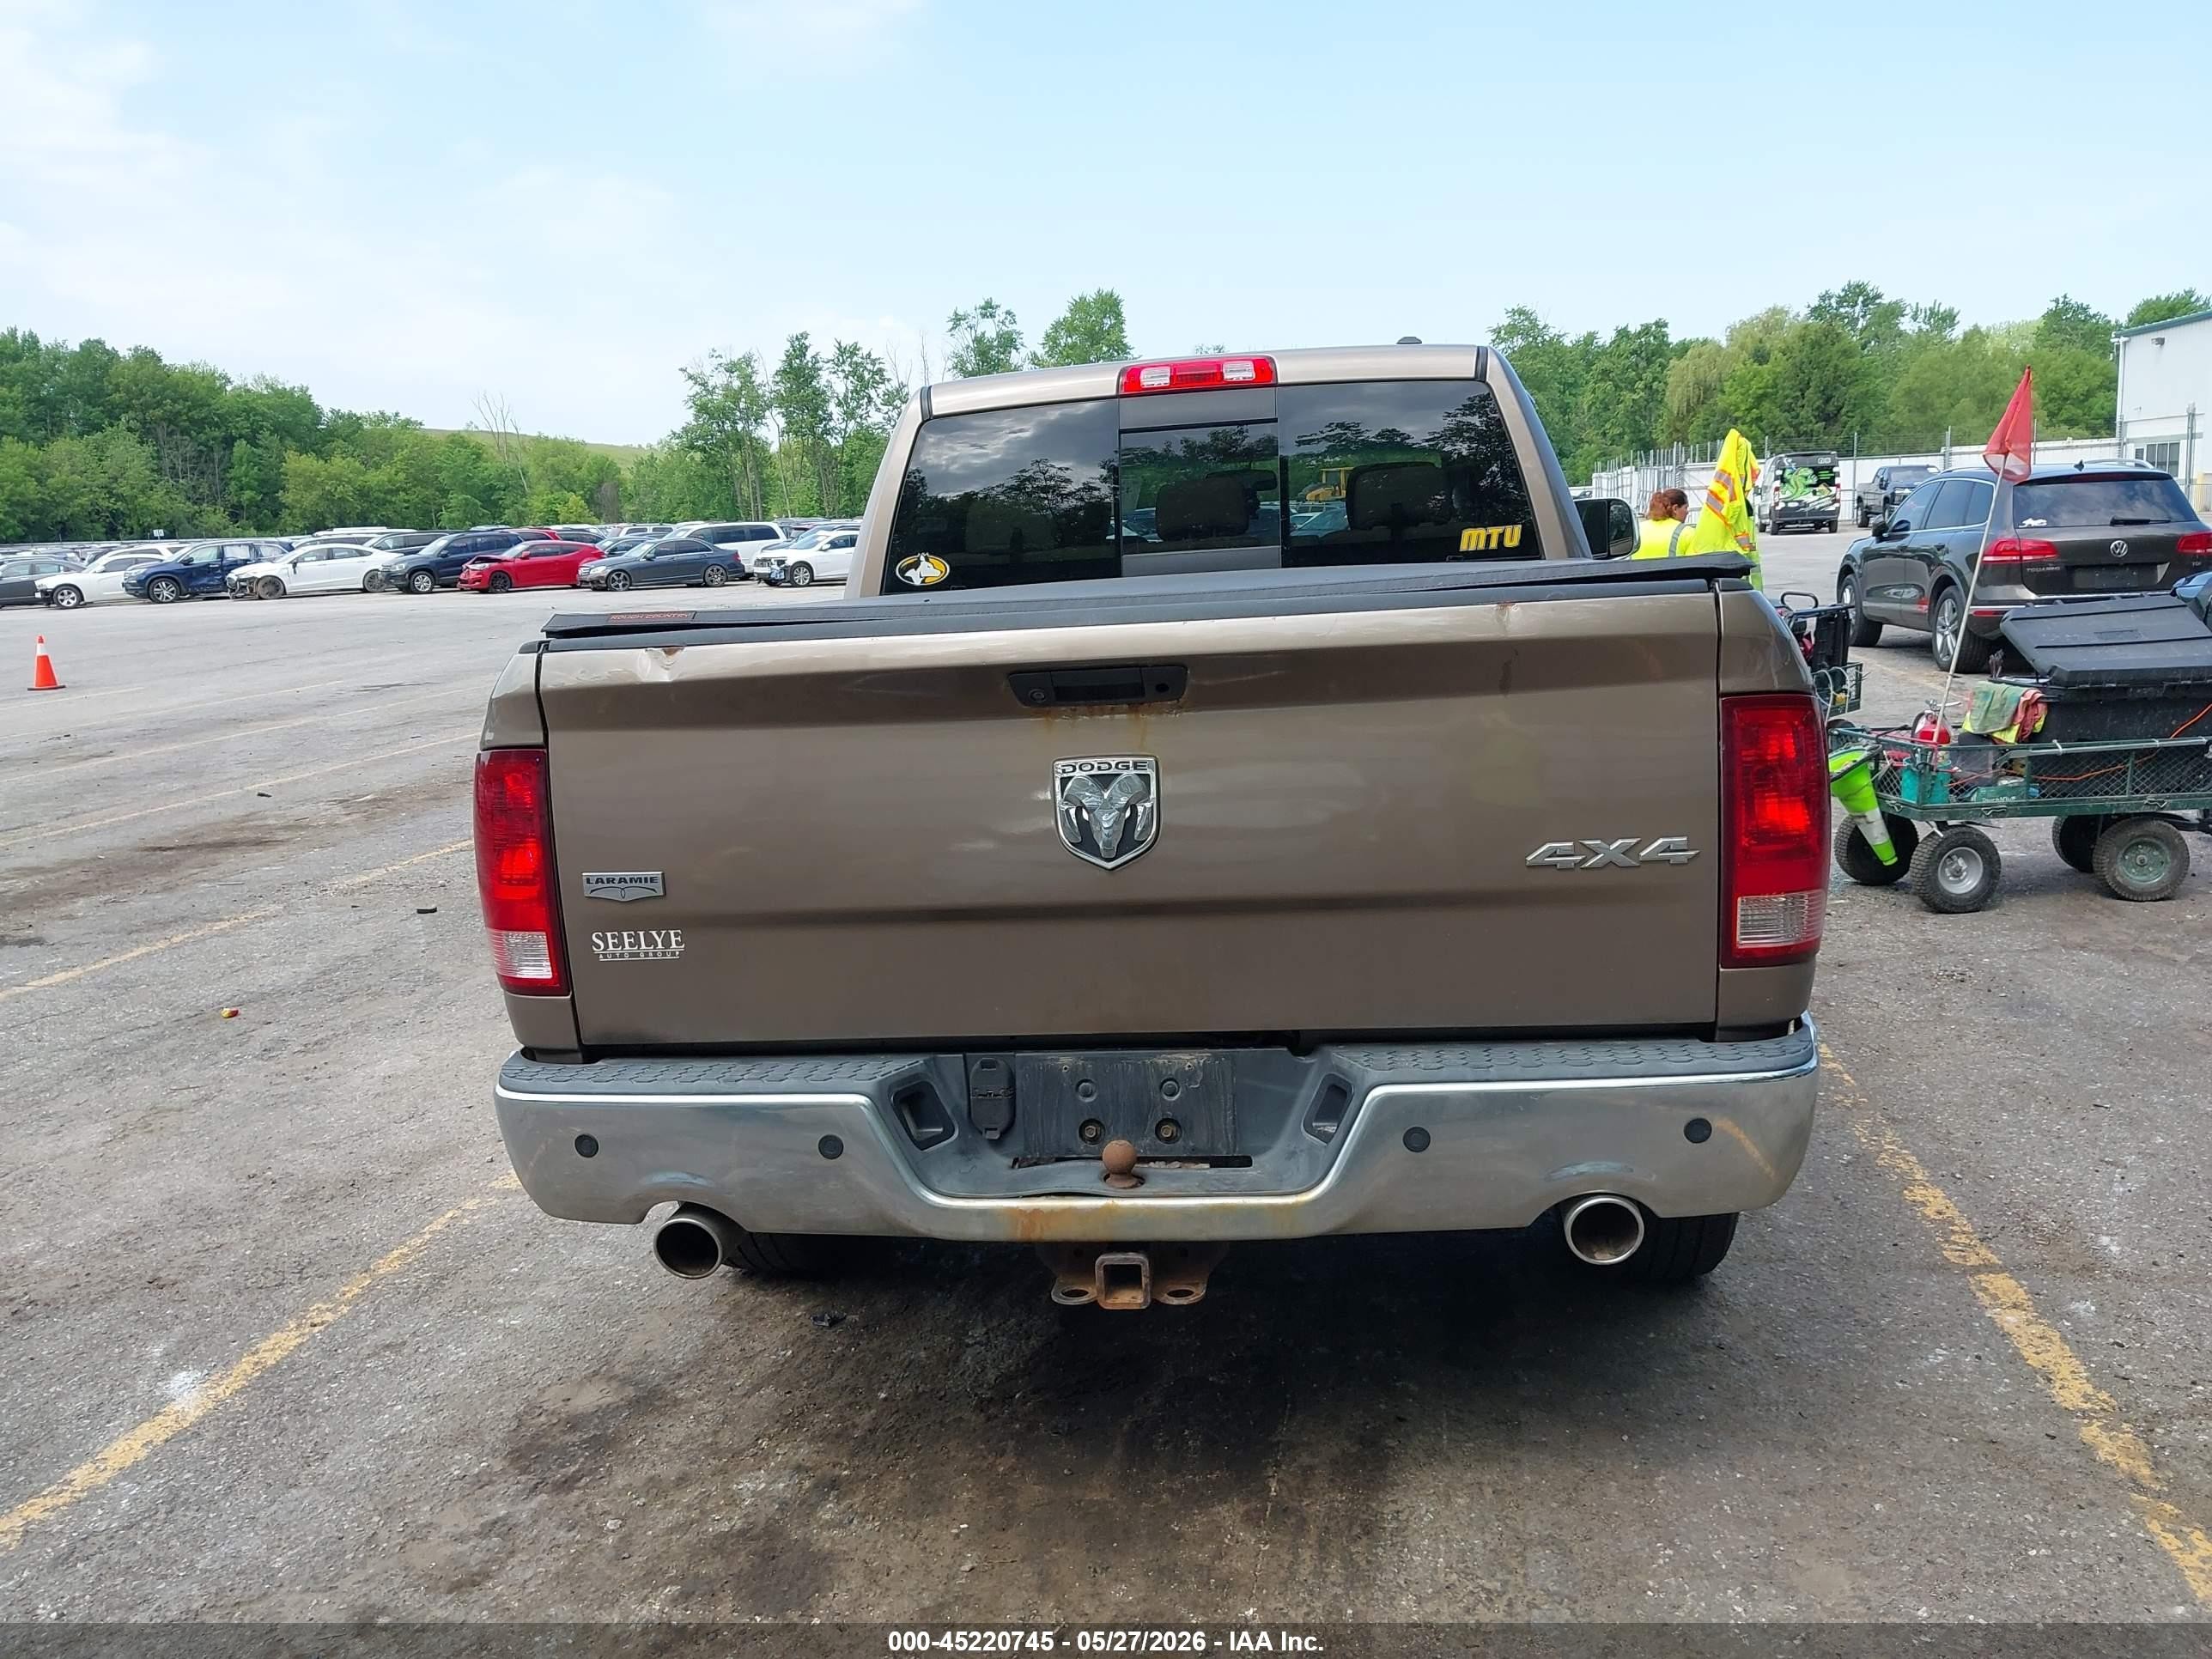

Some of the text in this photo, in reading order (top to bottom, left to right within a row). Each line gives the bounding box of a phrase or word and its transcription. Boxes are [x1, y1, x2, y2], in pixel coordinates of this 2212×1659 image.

[1459, 525, 1522, 551] MTU
[1060, 761, 1148, 774] DODGE
[1525, 836, 1700, 870] 4X4
[586, 876, 659, 884] LARAMIE
[591, 929, 685, 951] SEELYE
